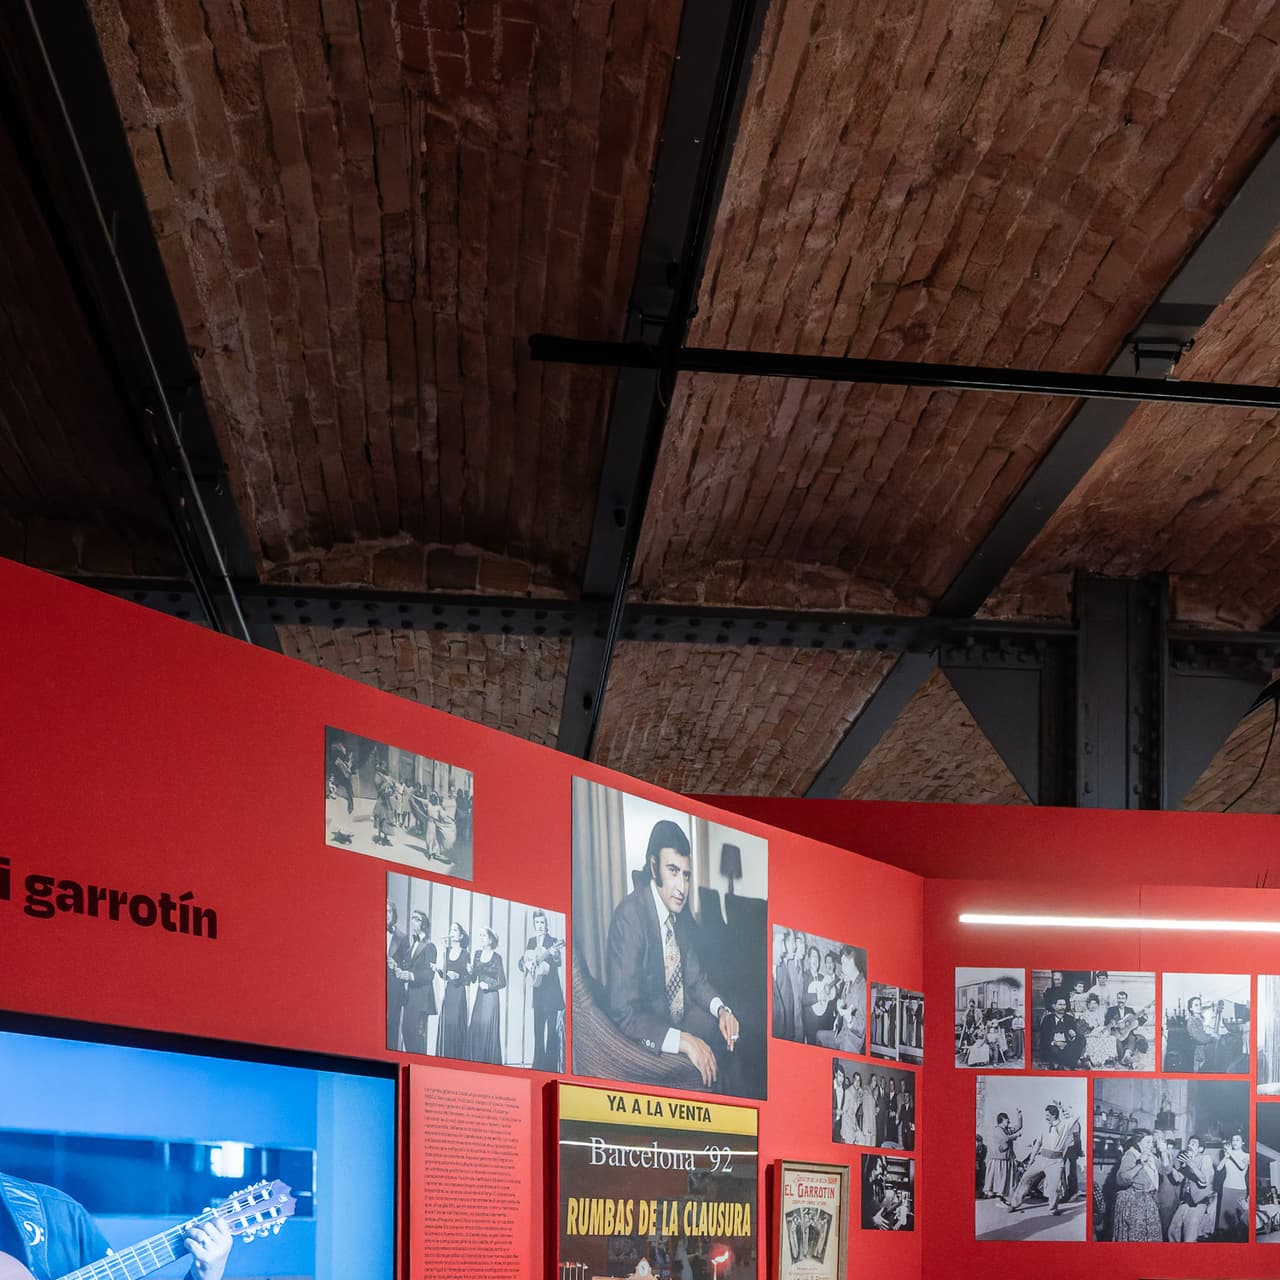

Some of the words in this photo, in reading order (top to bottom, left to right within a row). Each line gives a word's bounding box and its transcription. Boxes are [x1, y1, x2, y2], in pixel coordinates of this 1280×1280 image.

[23, 873, 218, 940] garrotín
[607, 1094, 626, 1112] YA
[632, 1098, 641, 1115] A
[647, 1100, 663, 1117] LA
[668, 1103, 712, 1123] VENTA
[589, 1137, 696, 1171] Barcelona
[784, 1183, 794, 1196] EL
[566, 1198, 633, 1236] RUMBAS
[638, 1199, 657, 1236] DE
[661, 1200, 678, 1237] LA
[683, 1201, 751, 1237] CLAUSURA
